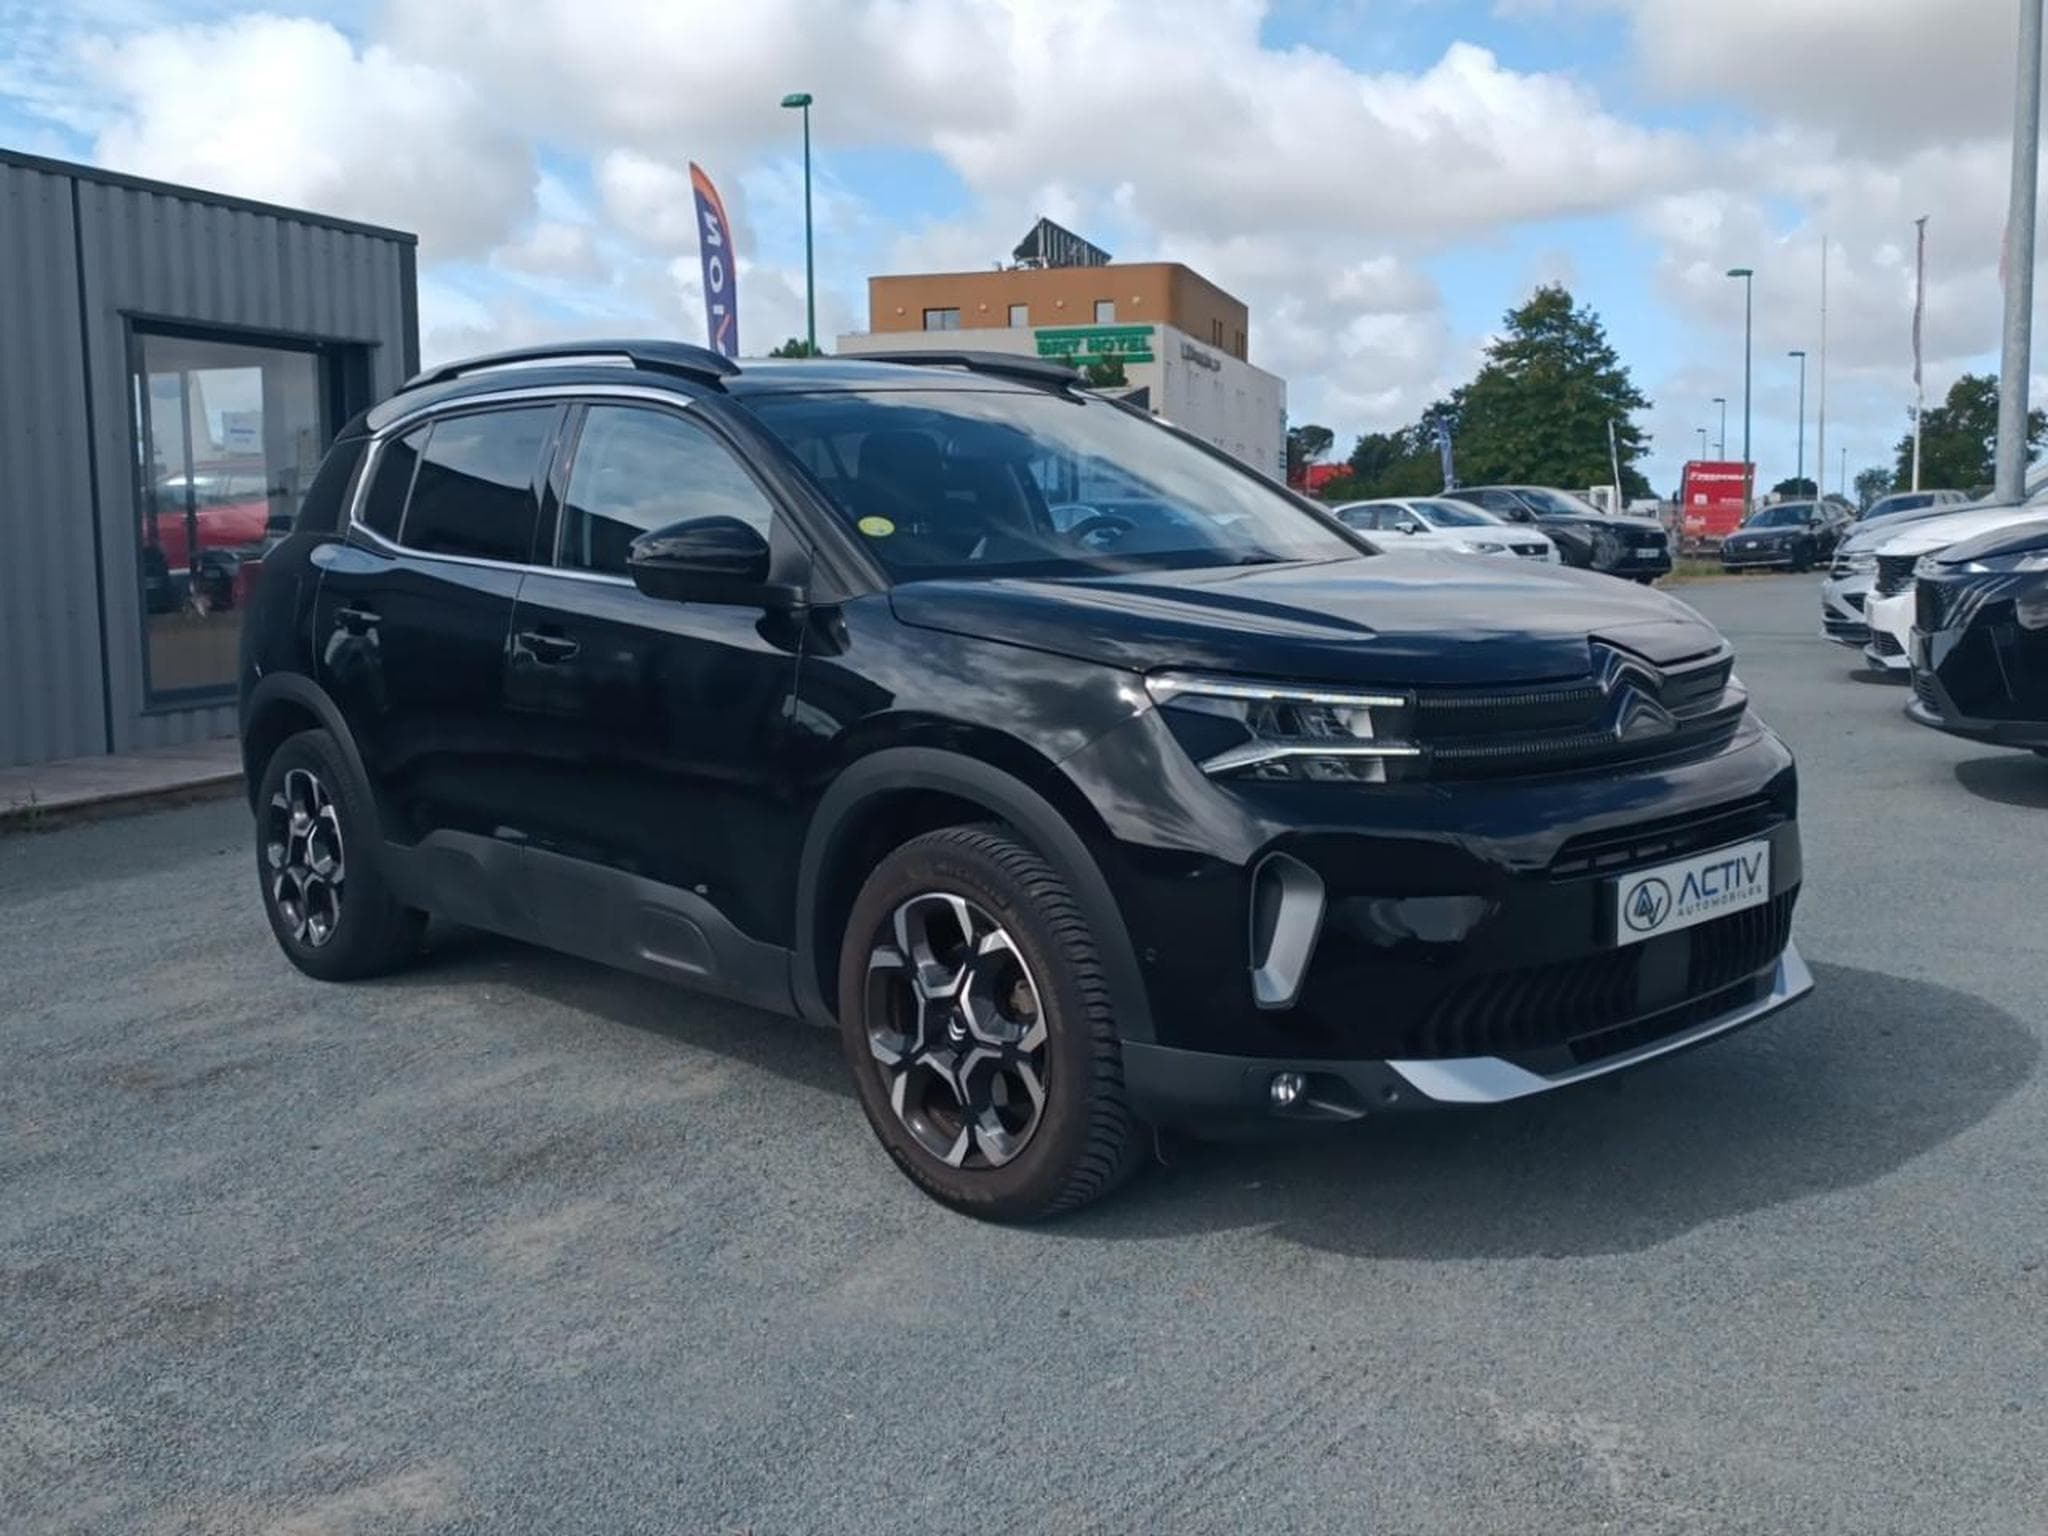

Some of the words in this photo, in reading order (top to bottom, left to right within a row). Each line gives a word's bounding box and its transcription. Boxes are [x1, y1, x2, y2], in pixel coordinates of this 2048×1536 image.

[1087, 335, 1151, 353] HOTEL
[1678, 851, 1762, 905] ACTIV
[1677, 885, 1762, 917] AUTOMOBILES
